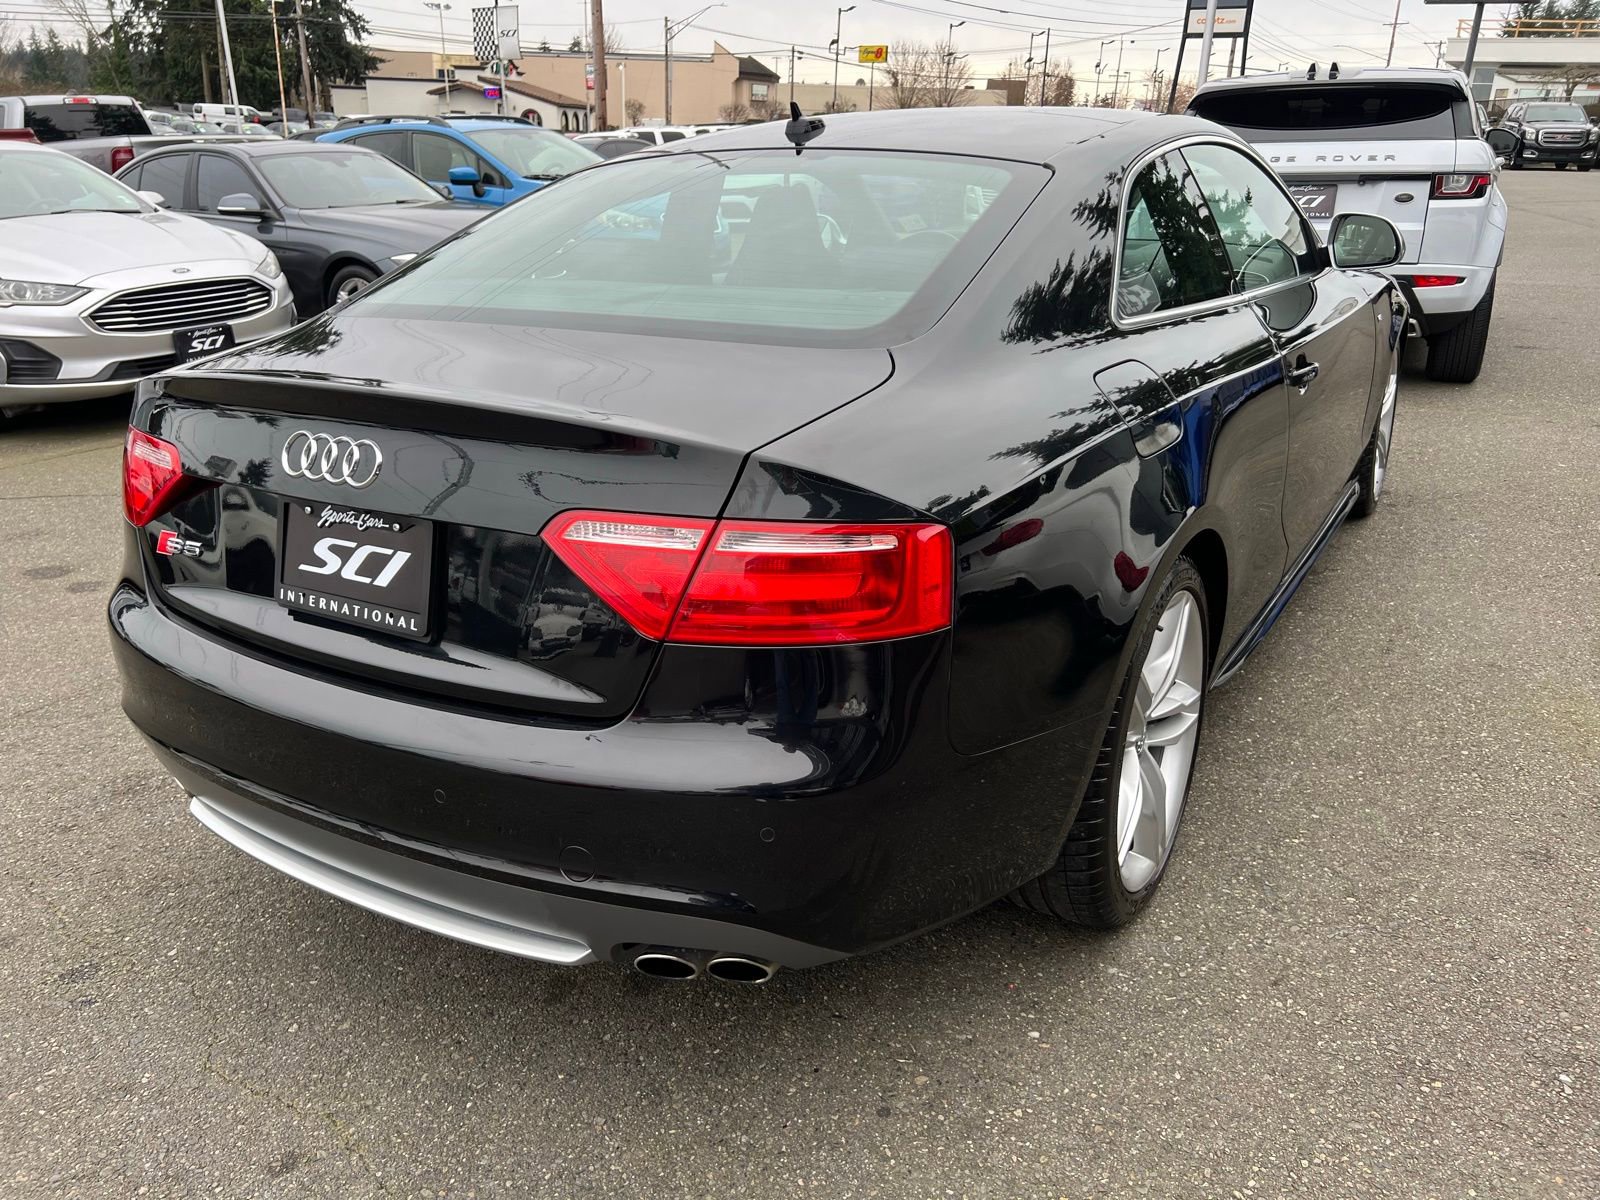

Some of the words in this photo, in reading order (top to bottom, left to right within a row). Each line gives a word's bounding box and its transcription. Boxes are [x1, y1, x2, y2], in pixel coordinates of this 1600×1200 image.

[500, 29, 517, 38] SCI
[1316, 154, 1397, 162] ROVER
[1293, 195, 1327, 208] CI
[188, 334, 226, 353] SCI
[317, 505, 359, 527] Sports
[357, 513, 390, 531] Cars
[298, 537, 412, 588] SCI
[280, 588, 418, 631] INTERNATIONAL
